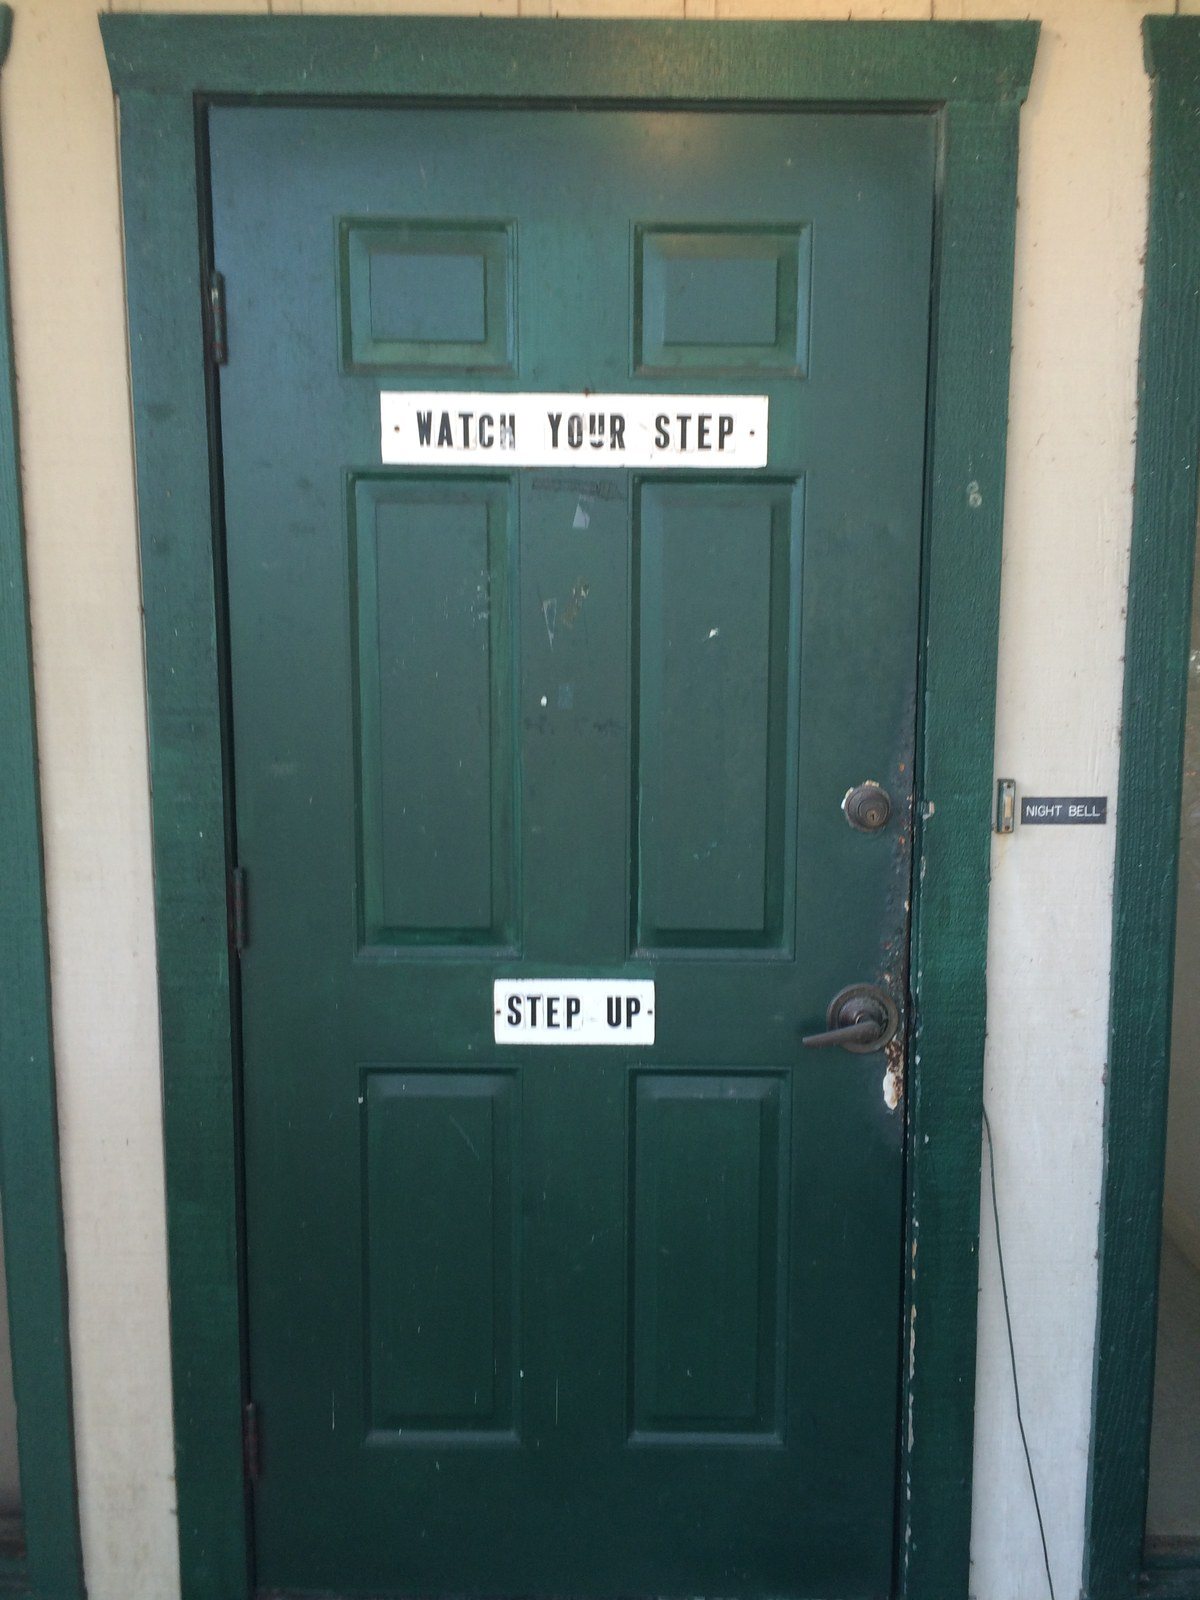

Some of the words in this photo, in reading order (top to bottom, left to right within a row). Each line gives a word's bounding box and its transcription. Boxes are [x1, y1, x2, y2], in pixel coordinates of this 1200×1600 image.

[416, 411, 516, 450] WATCH
[547, 412, 626, 449] YOUR
[655, 414, 734, 449] STEP
[1026, 804, 1063, 817] NIGHT
[1068, 804, 1101, 817] BELL
[507, 995, 581, 1029] STEP
[606, 996, 641, 1029] UP
